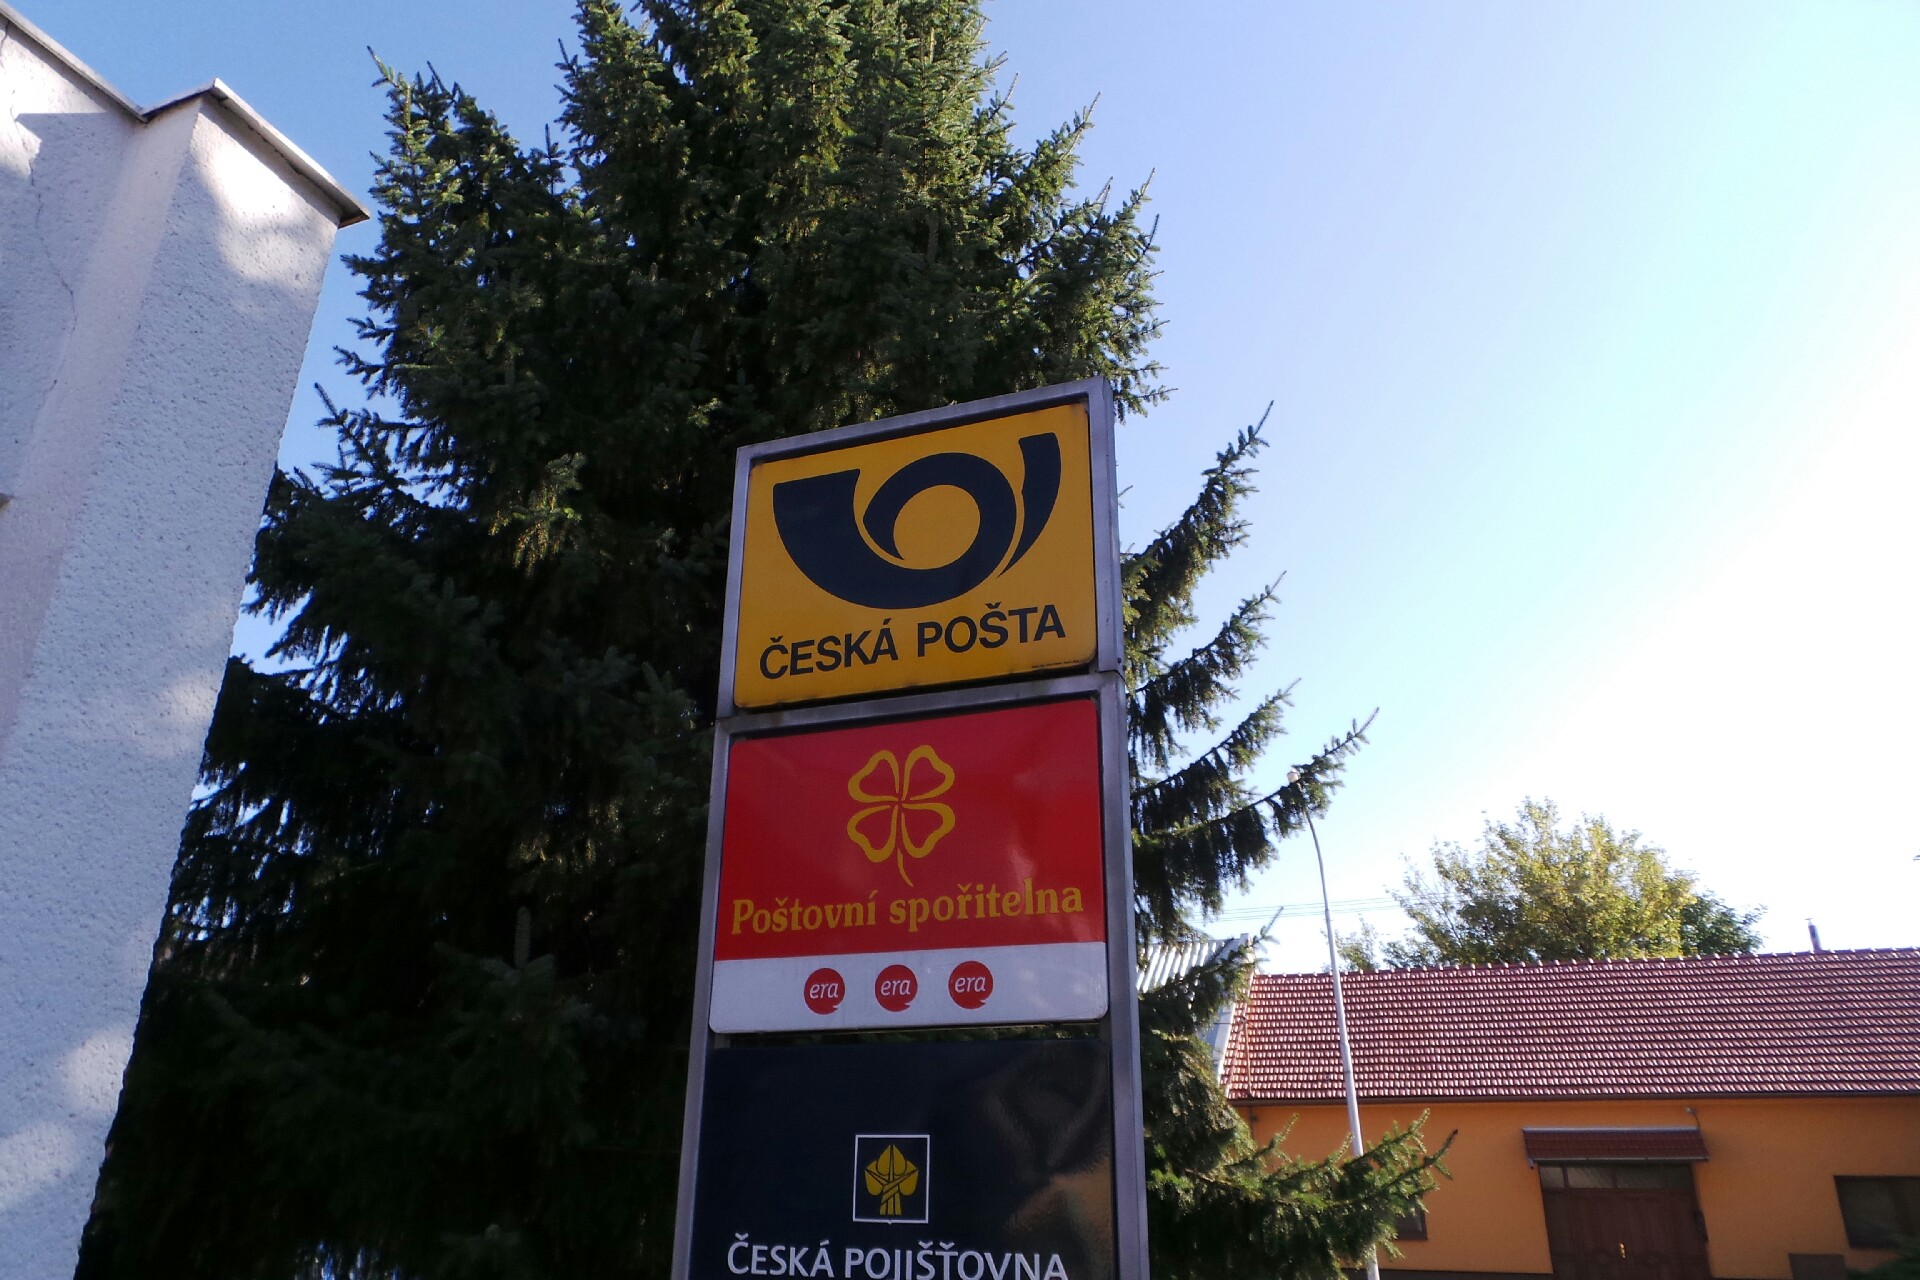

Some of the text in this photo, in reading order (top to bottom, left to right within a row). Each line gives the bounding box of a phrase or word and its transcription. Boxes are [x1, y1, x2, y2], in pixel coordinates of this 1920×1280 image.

[759, 602, 1066, 679] ČESKÁ POŠTA
[732, 878, 1084, 935] Poštovní spořitelna
[809, 983, 839, 999] era
[881, 979, 911, 996] era
[954, 975, 987, 993] era
[727, 1232, 1069, 1280] ČESKÁ POJIŠŤOVNA
